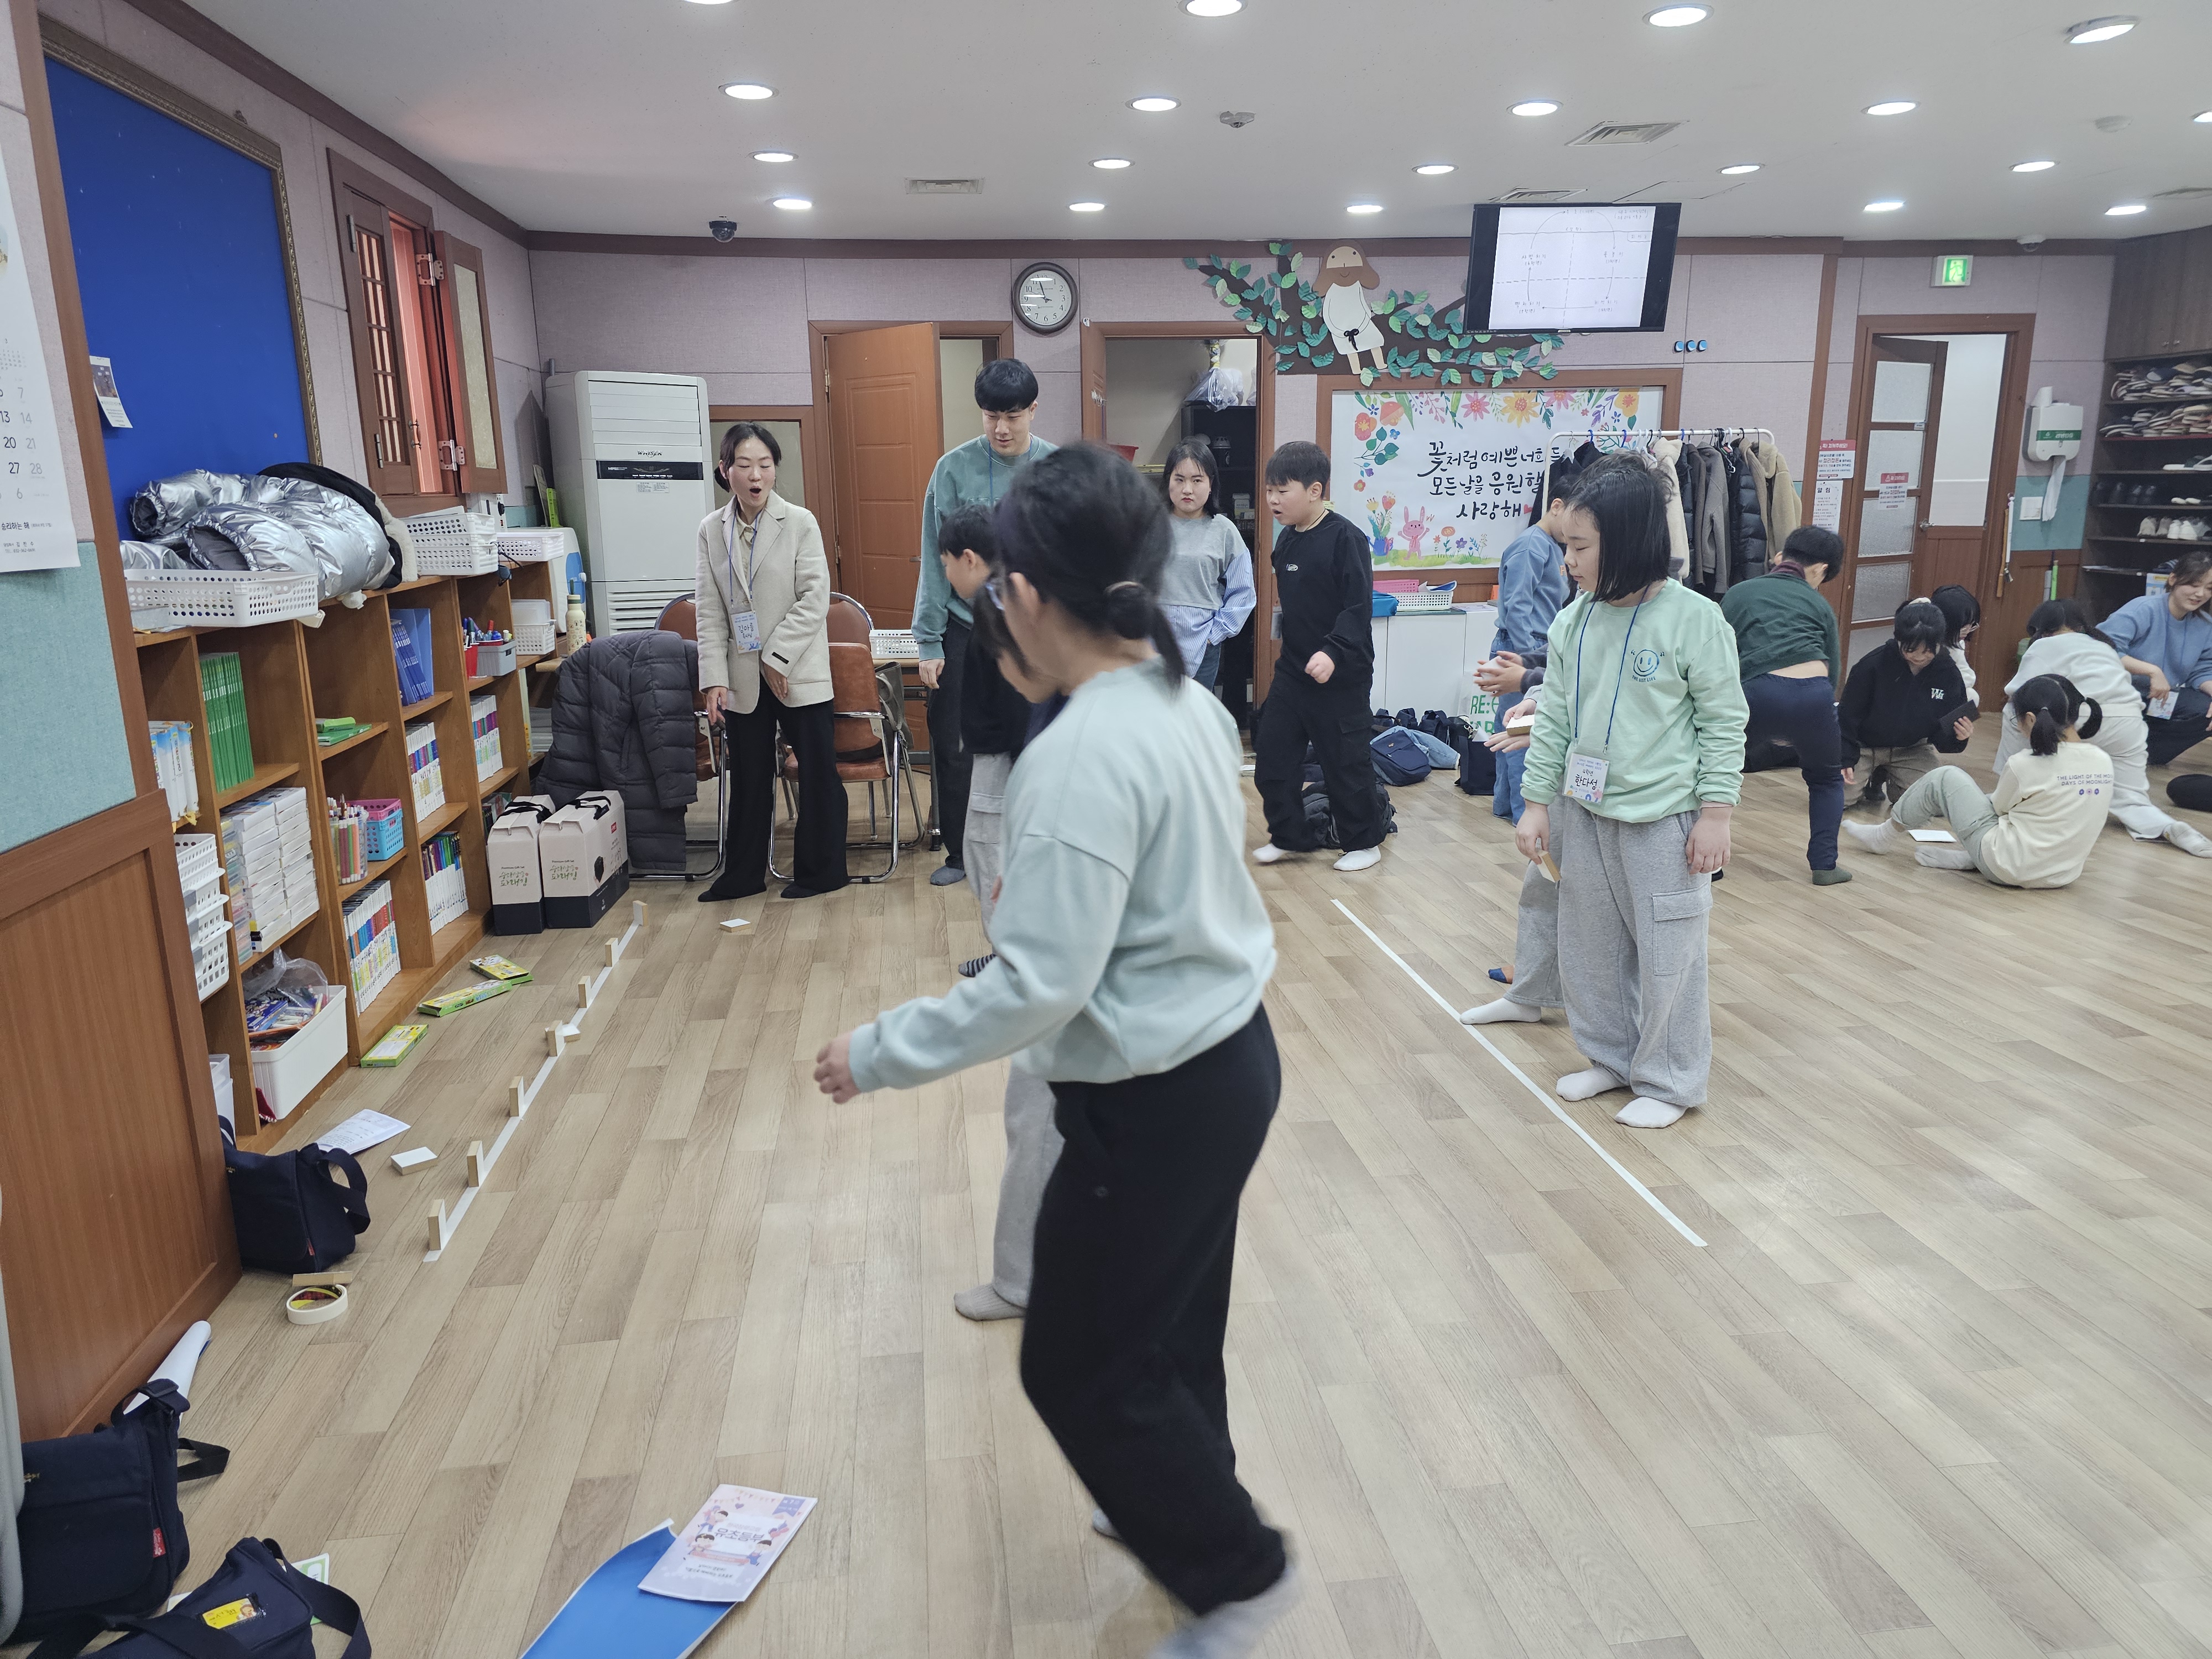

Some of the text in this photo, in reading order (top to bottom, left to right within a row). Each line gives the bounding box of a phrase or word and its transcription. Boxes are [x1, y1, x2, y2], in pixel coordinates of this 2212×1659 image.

[18, 387, 23, 399] 7
[20, 413, 32, 424] 14
[3, 436, 36, 449] 20 21
[1417, 441, 1478, 477] 꽃처럼
[1481, 445, 1519, 467] 예쁜
[8, 462, 43, 474] 27 28
[1429, 476, 1457, 496] 모든
[1459, 474, 1484, 495] 날을
[17, 488, 23, 499] 6
[1456, 499, 1521, 520] 사랑해
[2, 522, 23, 530] 승리하는
[1575, 774, 1598, 790] 한다성
[714, 1527, 765, 1542] 유초등부
